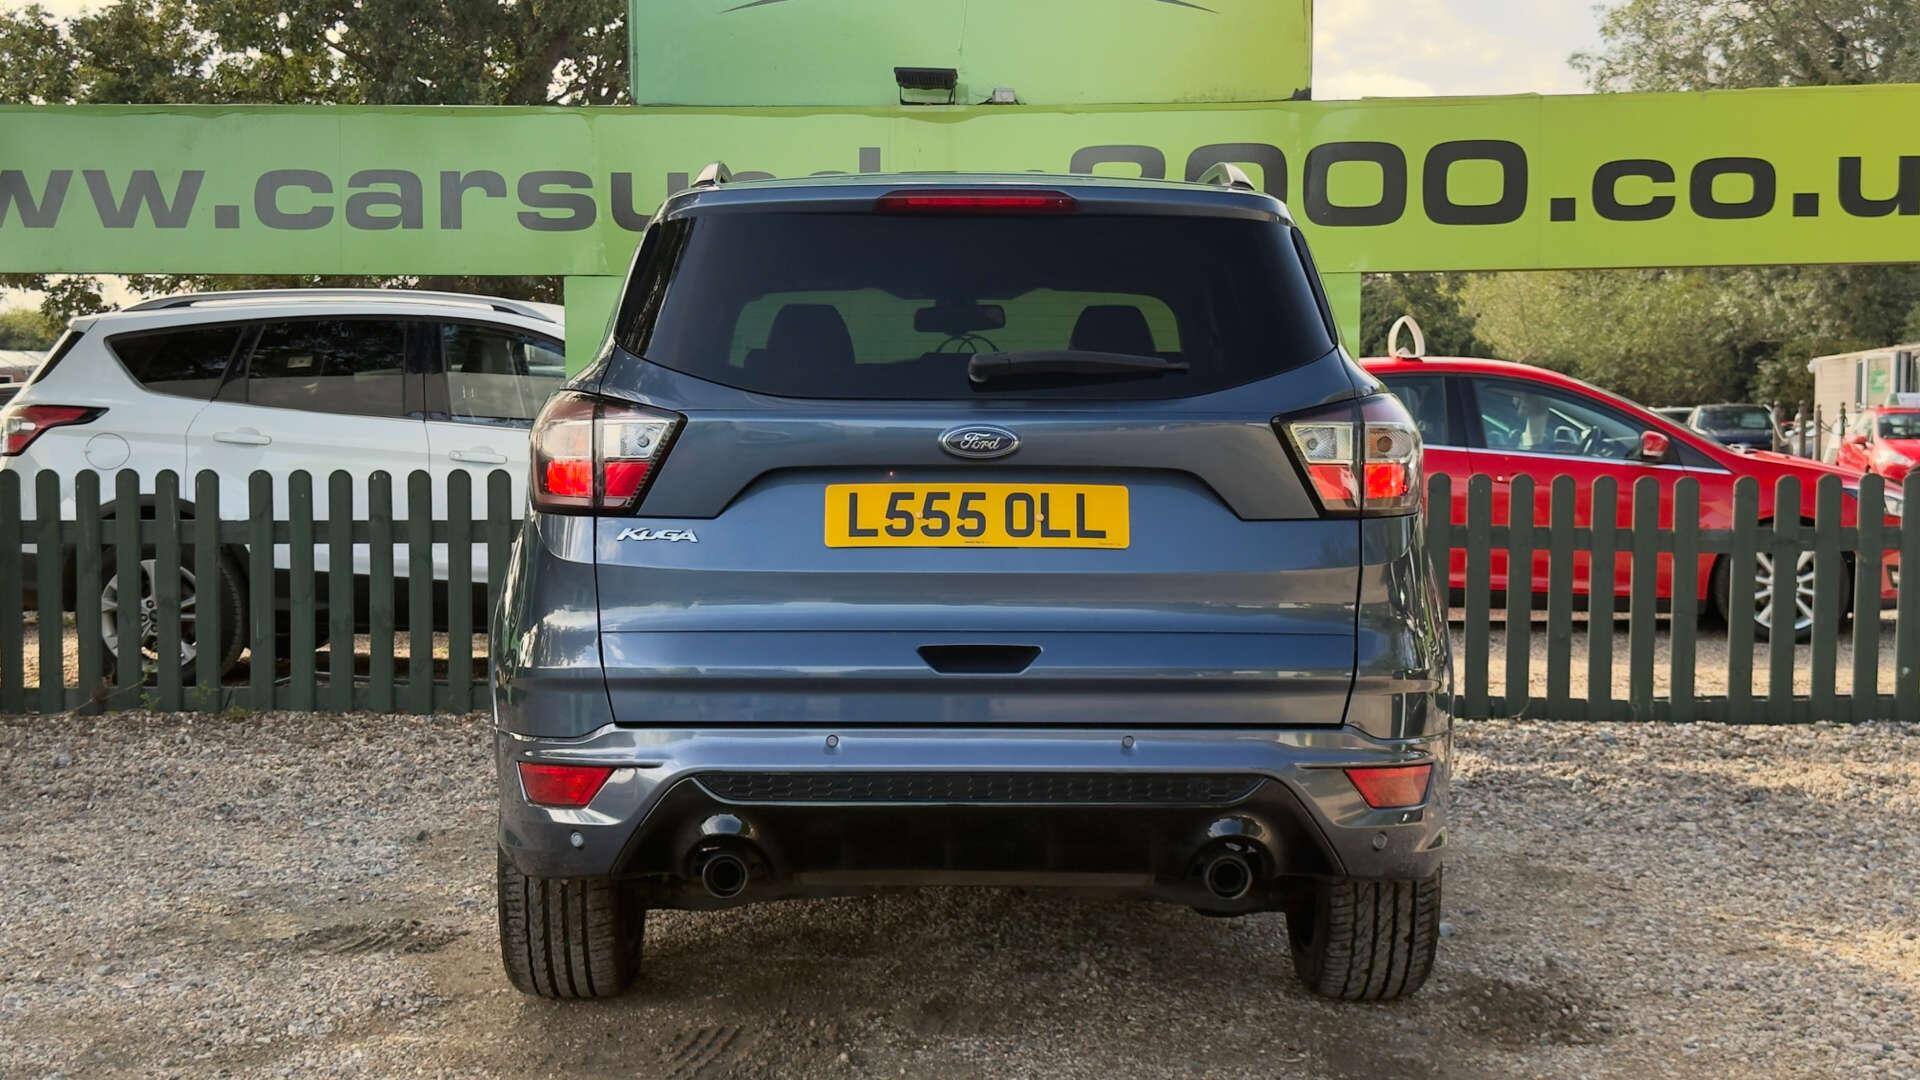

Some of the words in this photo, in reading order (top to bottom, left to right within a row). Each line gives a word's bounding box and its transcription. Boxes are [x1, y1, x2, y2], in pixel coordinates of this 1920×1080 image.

[960, 432, 1001, 449] Ford
[848, 491, 987, 538] L555
[1004, 492, 1107, 539] OLL
[615, 527, 699, 543] KUGA
